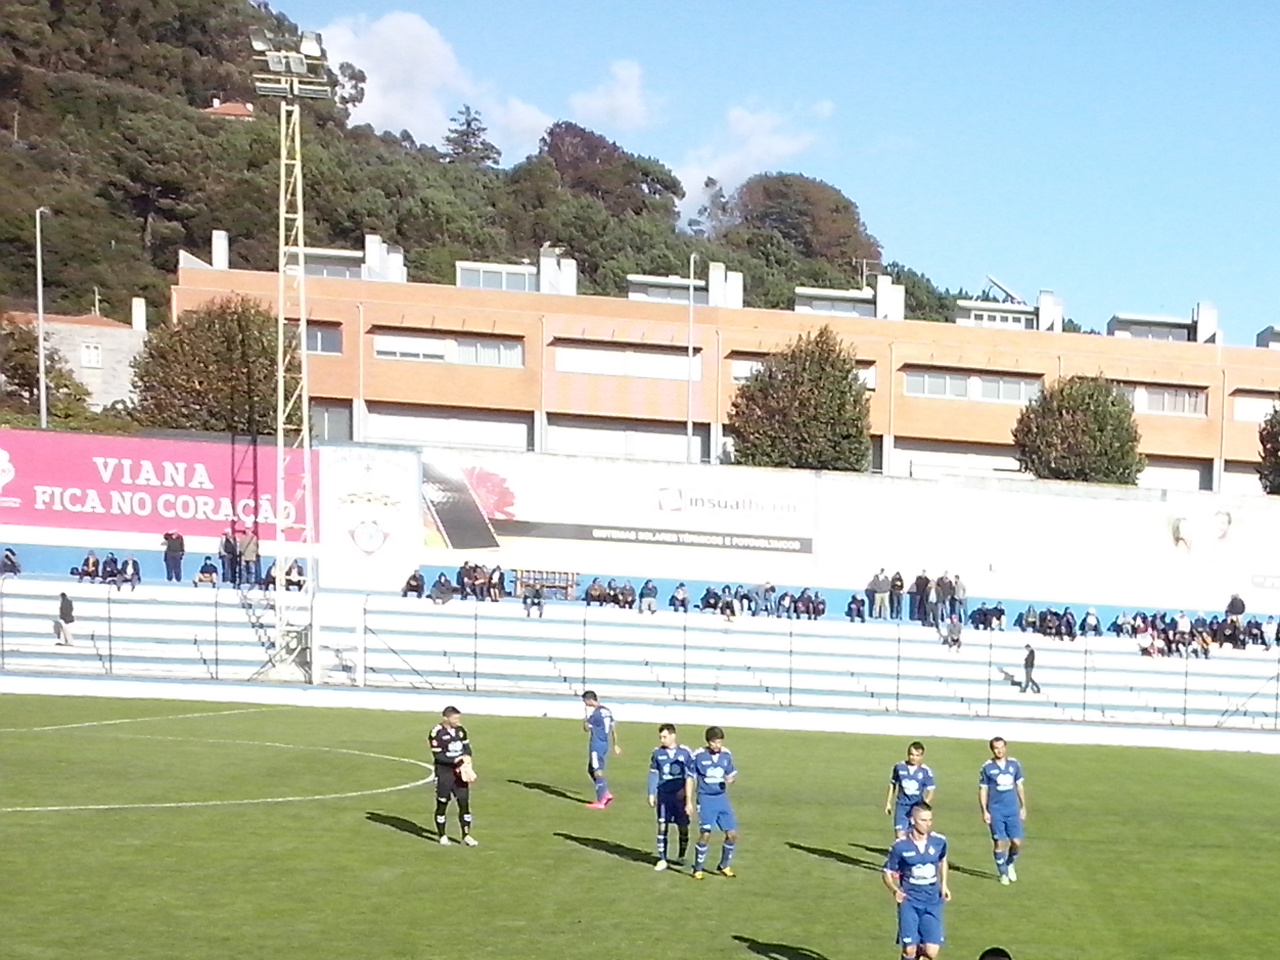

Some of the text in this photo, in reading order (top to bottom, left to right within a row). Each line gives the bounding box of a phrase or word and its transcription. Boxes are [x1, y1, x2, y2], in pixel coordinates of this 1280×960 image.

[92, 456, 214, 490] VIANA
[34, 485, 297, 527] FICA NO CORAÇÃO
